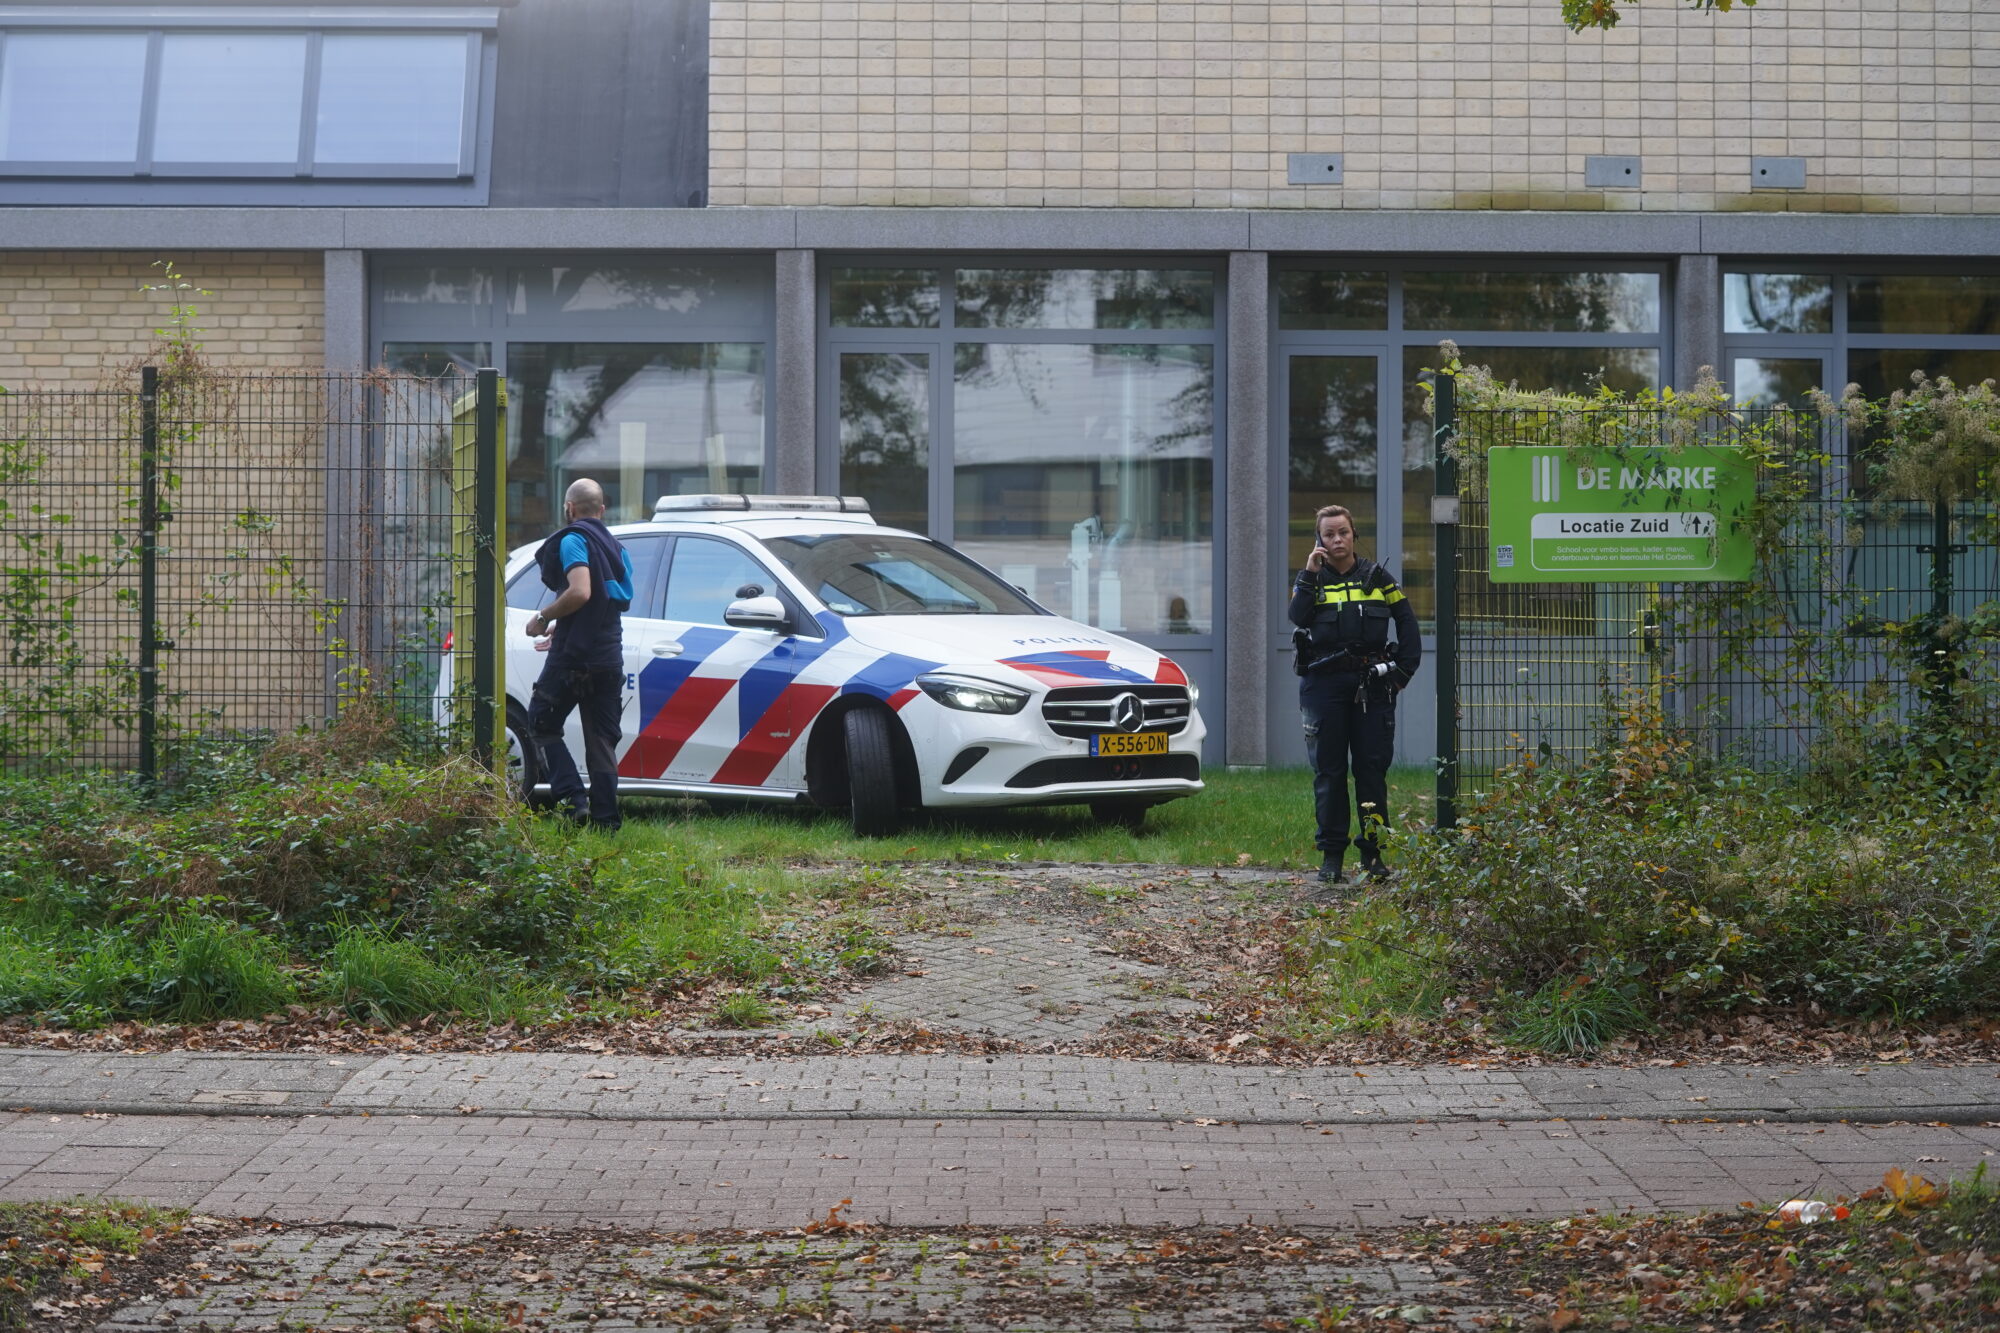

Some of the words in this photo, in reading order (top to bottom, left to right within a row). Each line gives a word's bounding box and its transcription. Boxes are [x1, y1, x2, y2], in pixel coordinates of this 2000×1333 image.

[1577, 467, 1611, 490] DE
[1618, 466, 1717, 490] MARKE
[1560, 519, 1624, 533] Locatie
[1630, 518, 1669, 533] Zuid
[1556, 545, 1581, 553] School
[1551, 554, 1590, 562] onderbouw
[1012, 637, 1108, 646] POLITIE
[1102, 734, 1165, 753] X-556-DN
